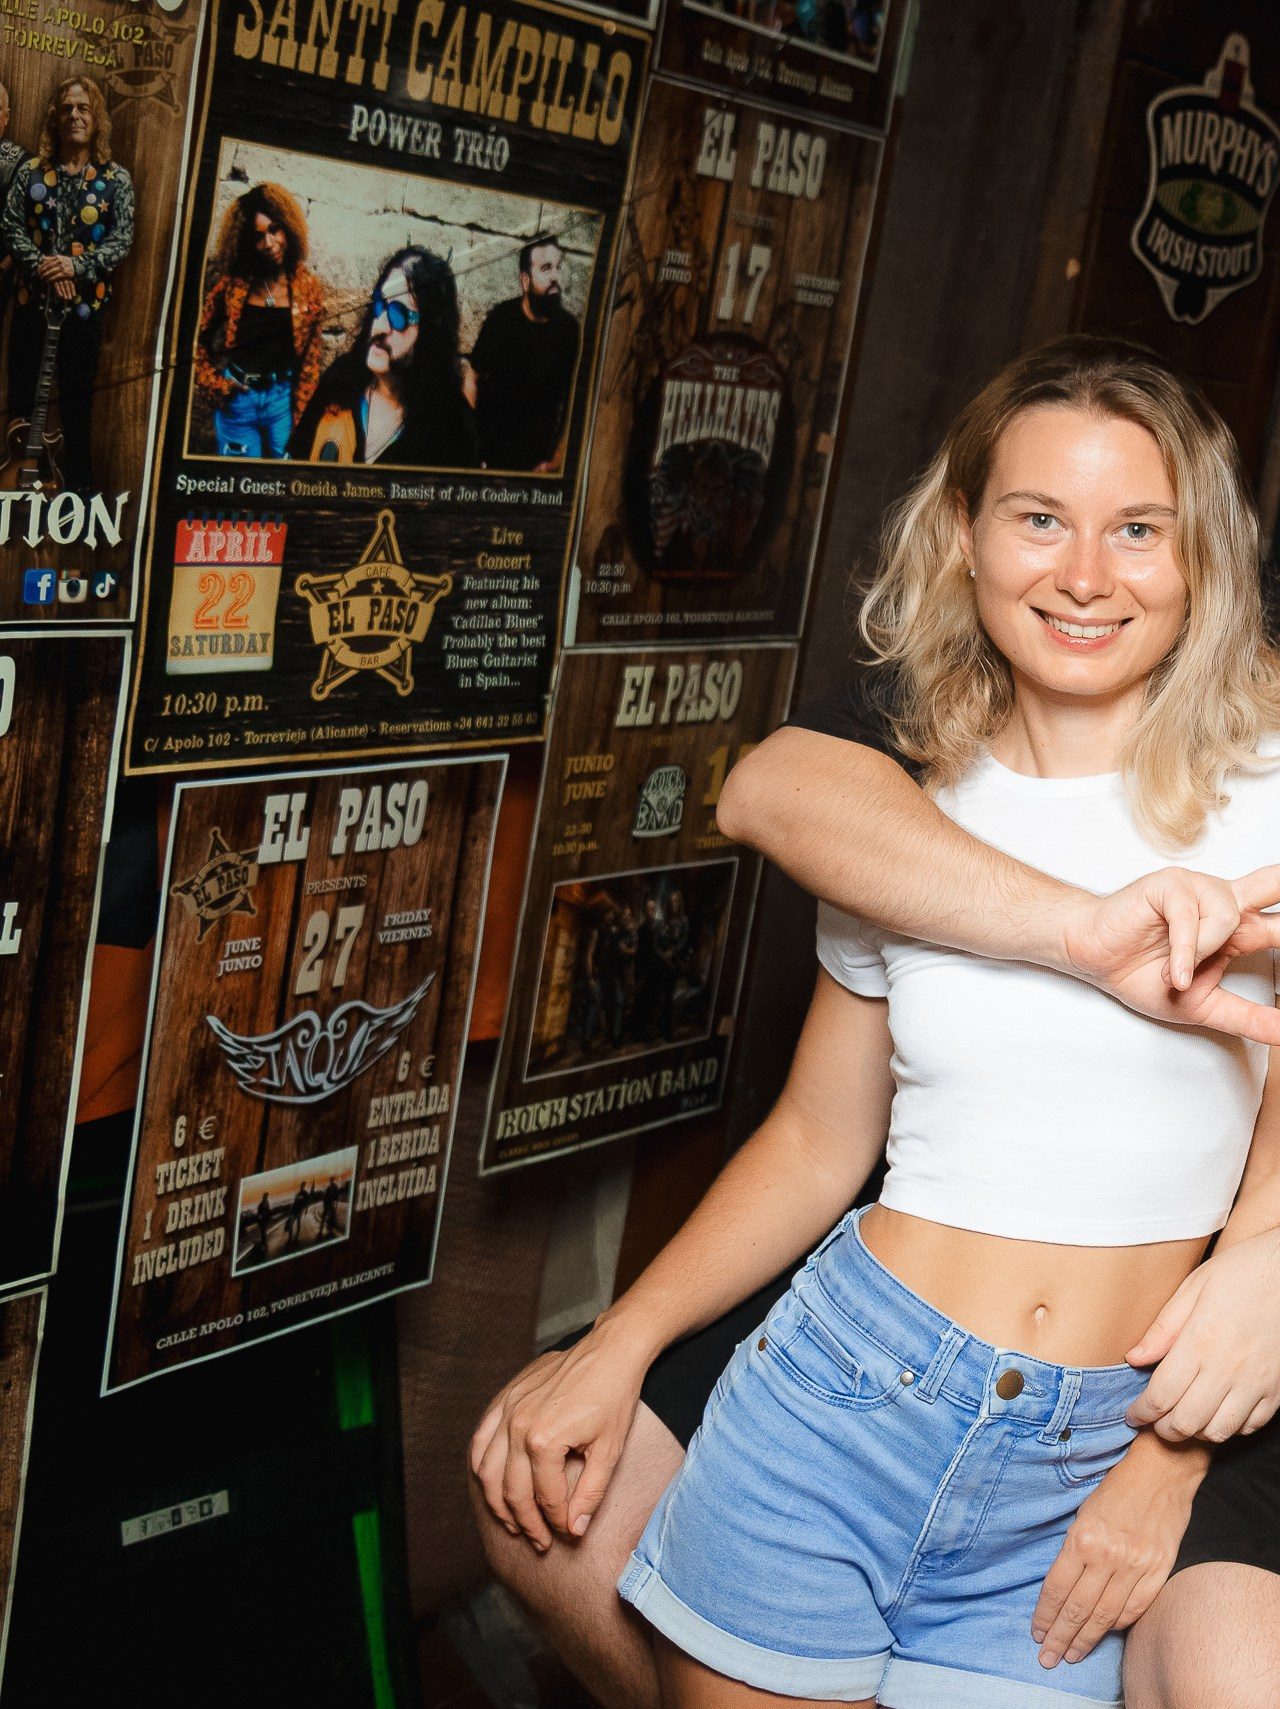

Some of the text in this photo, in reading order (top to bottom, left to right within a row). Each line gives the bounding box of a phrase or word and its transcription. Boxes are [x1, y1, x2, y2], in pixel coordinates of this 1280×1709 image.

[43, 8, 105, 35] APOLO
[233, 0, 632, 147] SANTI CAMPILLO
[349, 104, 511, 173] POWER TRÍO
[696, 107, 828, 201] EL PASO
[1146, 217, 1255, 280] IRISH STOUT
[659, 266, 692, 285] JUNIO
[717, 242, 772, 325] 17
[713, 365, 740, 382] THE
[176, 474, 235, 495] Special
[240, 477, 287, 497] Guest:
[291, 480, 338, 499] Oneida
[390, 483, 436, 500] Bassist
[439, 483, 454, 501] of
[457, 486, 479, 502] Joe
[482, 486, 530, 506] Cocker's
[532, 488, 564, 506] Band
[185, 530, 274, 563] APRIL
[491, 526, 524, 546] Live
[476, 551, 532, 570] Concert
[598, 564, 626, 578] 22:30
[463, 574, 540, 593] Featuring his
[585, 580, 612, 594] 10:30
[192, 570, 256, 631] 22
[327, 598, 420, 635] EL PASO
[465, 594, 533, 611] new album:
[169, 632, 272, 657] SATURDAY
[443, 633, 546, 652] Probably the best
[360, 655, 380, 666] BAR
[446, 652, 538, 671] Blues Guitarist
[460, 674, 472, 689] in
[615, 660, 744, 728] EL PASO
[161, 692, 270, 718] 10:30 p.m.
[144, 737, 159, 752] C/
[164, 733, 204, 752] Apolo
[208, 732, 232, 748] 102
[245, 726, 307, 746] Torrevieja
[311, 720, 368, 742] (Alicante)
[380, 718, 451, 737] Reservations
[563, 753, 616, 780] JUNIO
[562, 780, 608, 807] JUNE
[257, 779, 429, 866] EL PASO
[193, 884, 212, 908] EL
[217, 865, 250, 894] PASO
[305, 874, 368, 895] PRESENTS
[383, 908, 432, 927] FRIDAY
[223, 937, 262, 959] JUNE
[295, 903, 367, 996] 27
[378, 924, 433, 944] VIERNES
[217, 954, 263, 978] JUNIO
[397, 1050, 411, 1083] 6
[656, 1057, 719, 1097] BAND
[366, 1083, 450, 1129] ENTRADA
[173, 1114, 216, 1148] 6 €
[367, 1124, 440, 1169] 1 BEBIDA
[155, 1146, 226, 1196] TICKET
[142, 1185, 228, 1241] 1 DRINK
[131, 1226, 226, 1287] INCLUDED
[156, 1262, 396, 1350] CALLE APOLO 102, TORREVIEJA ALICANTE
